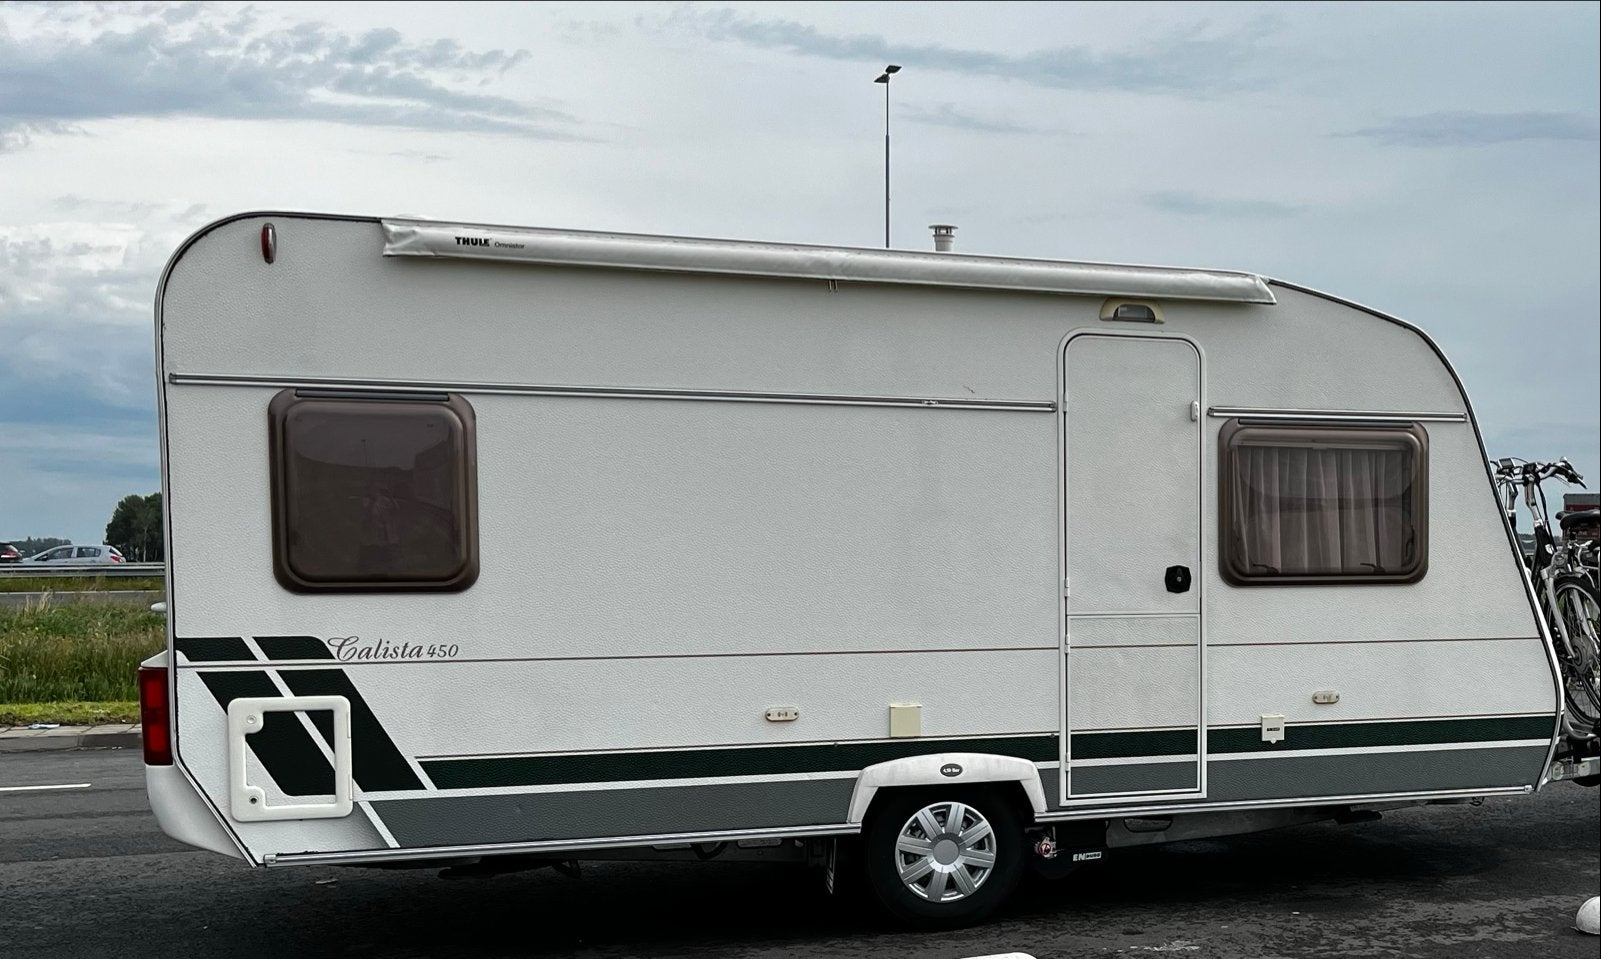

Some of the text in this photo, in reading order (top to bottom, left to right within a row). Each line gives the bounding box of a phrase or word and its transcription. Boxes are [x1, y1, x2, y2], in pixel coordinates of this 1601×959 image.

[455, 236, 525, 249] THULE Omnistor
[327, 635, 459, 662] Calista 450
